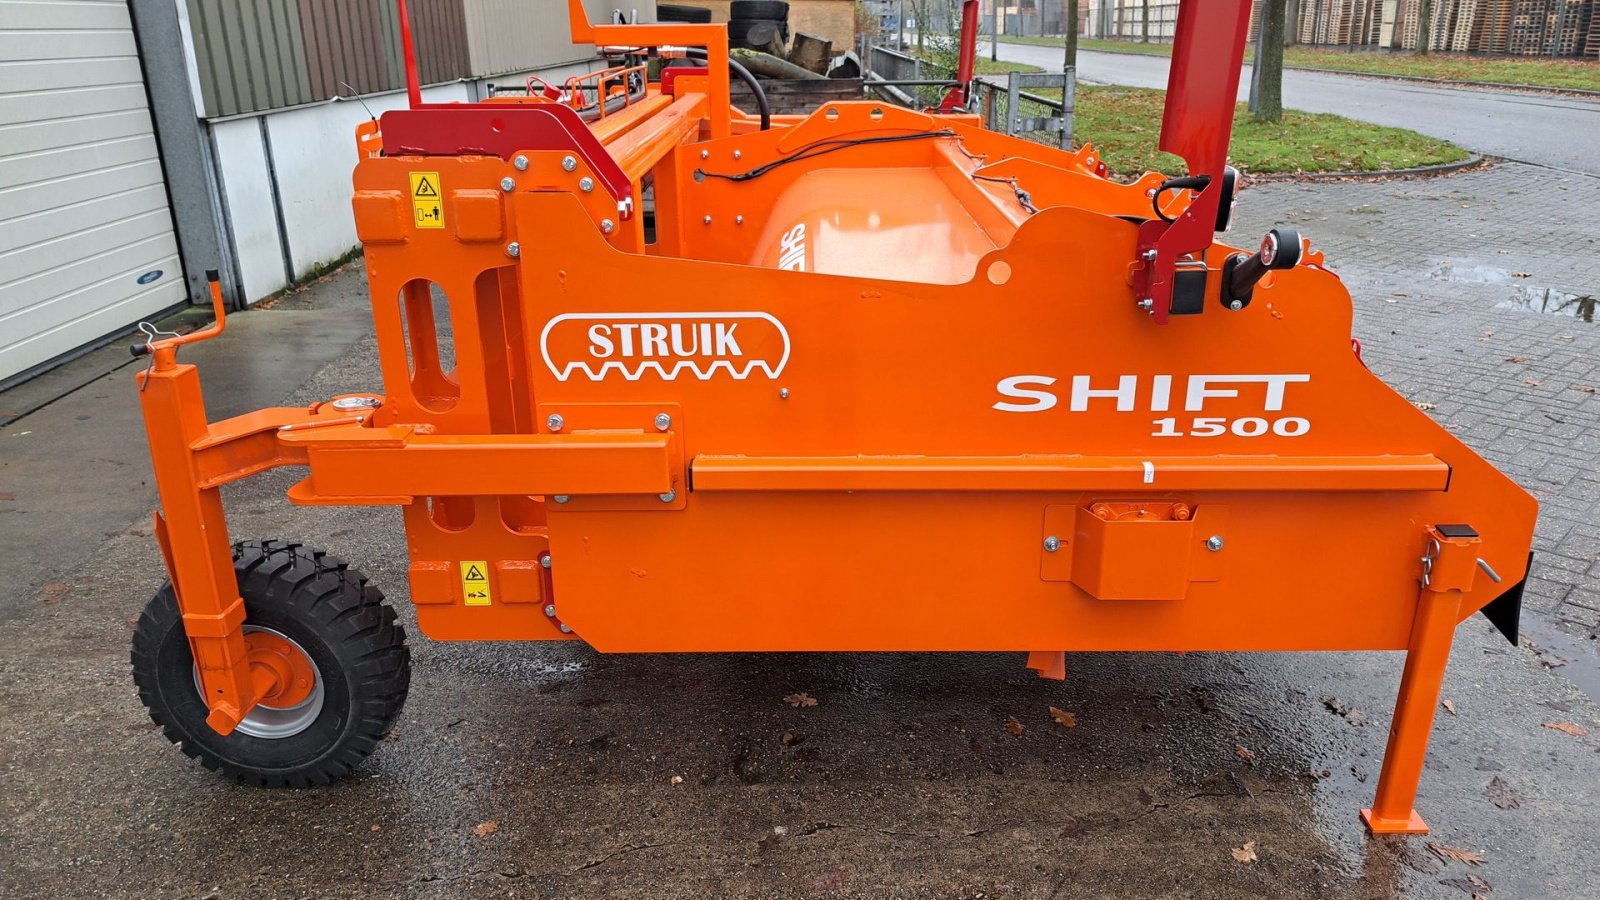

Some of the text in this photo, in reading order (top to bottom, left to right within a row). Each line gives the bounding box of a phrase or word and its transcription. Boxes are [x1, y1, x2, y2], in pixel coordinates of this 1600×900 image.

[778, 223, 806, 272] SHIF
[588, 322, 742, 358] STRUIK
[993, 374, 1311, 413] SHIFT
[1151, 417, 1311, 437] 1500
